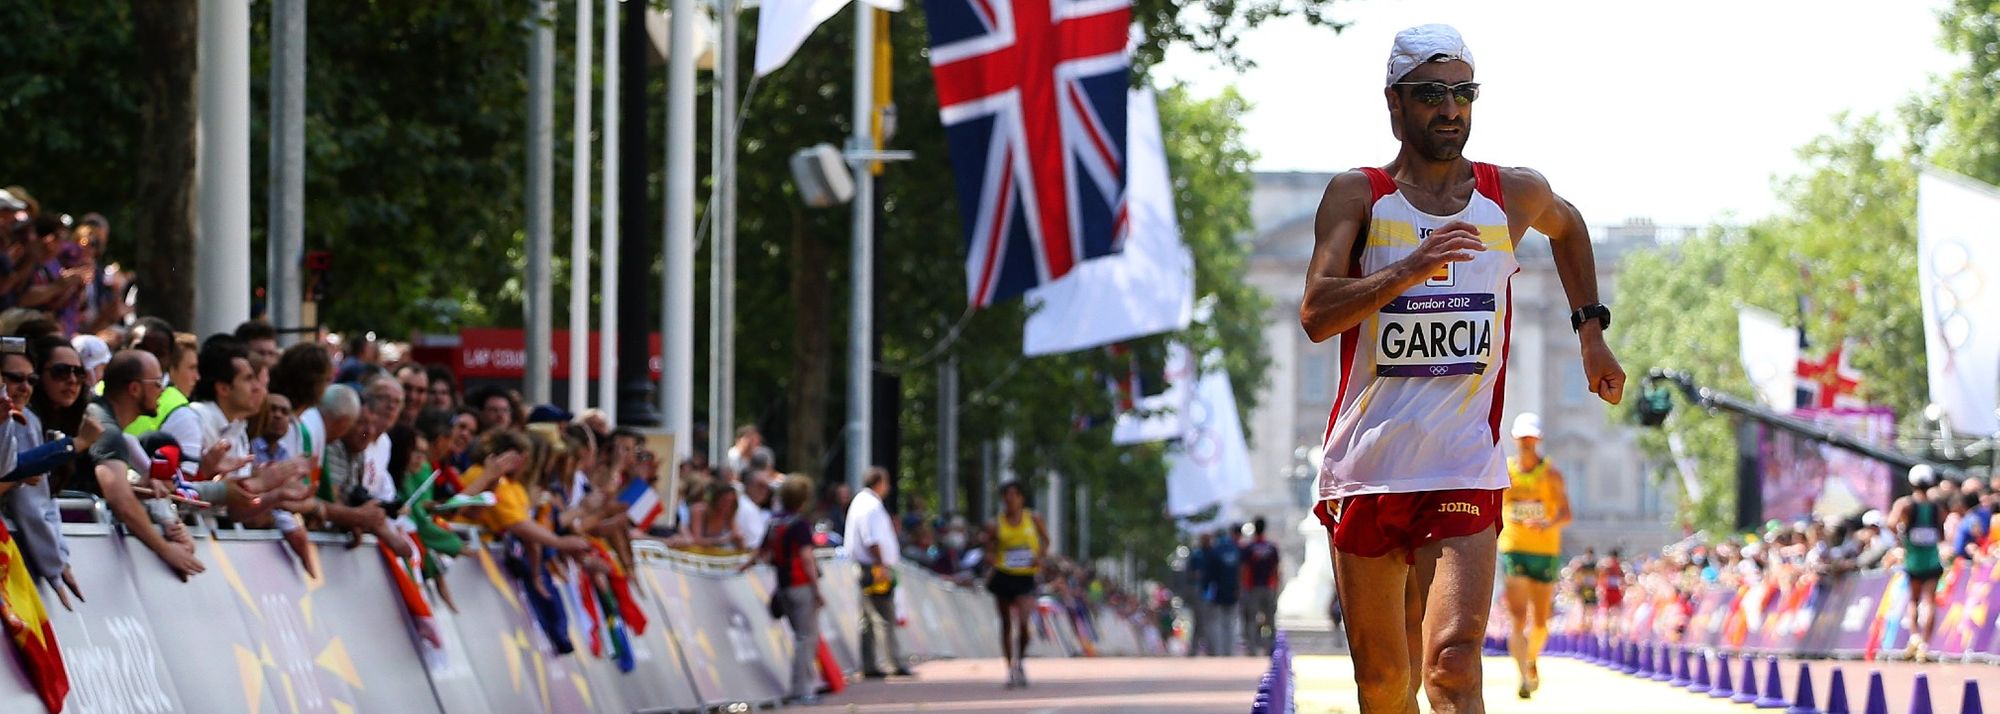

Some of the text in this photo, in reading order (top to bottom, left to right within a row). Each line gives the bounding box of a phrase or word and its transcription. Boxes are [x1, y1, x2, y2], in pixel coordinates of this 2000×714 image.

[1406, 297, 1471, 311] London 2012
[1381, 319, 1491, 359] GARCIA
